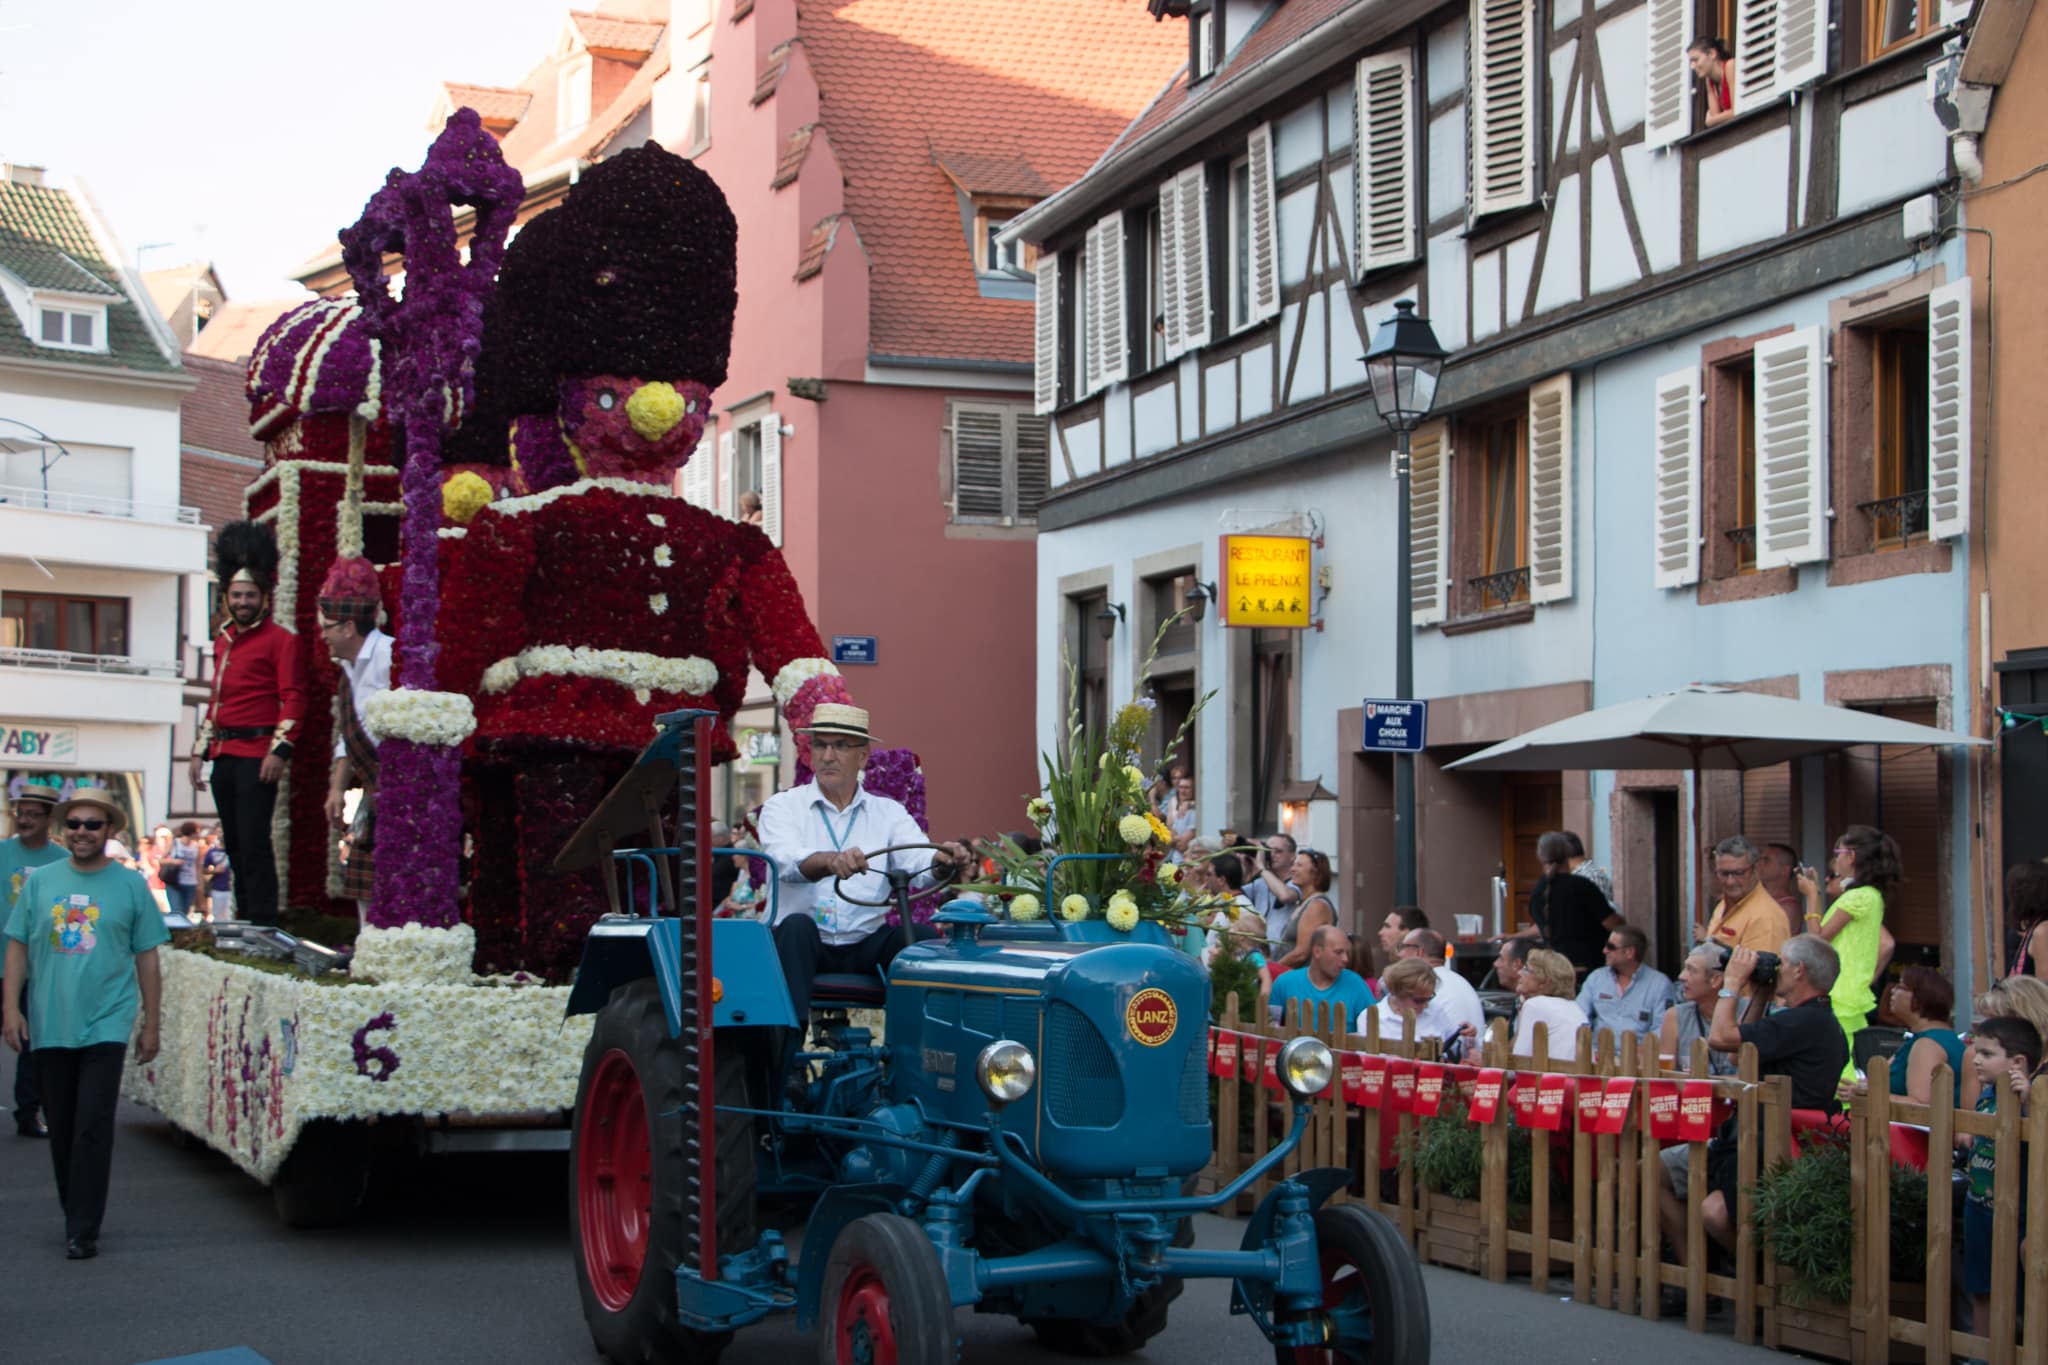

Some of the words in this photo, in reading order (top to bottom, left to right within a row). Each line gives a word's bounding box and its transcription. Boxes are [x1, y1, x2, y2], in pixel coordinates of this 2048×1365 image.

[1231, 547, 1305, 561] RESTAURANT
[1236, 572, 1249, 586] LE
[1377, 704, 1411, 716] MARCHÉ
[1384, 716, 1402, 726] AUX
[1378, 727, 1408, 738] CHOUX
[0, 728, 51, 755] ABY
[1136, 1010, 1169, 1024] LANZ
[352, 1010, 399, 1081] 6
